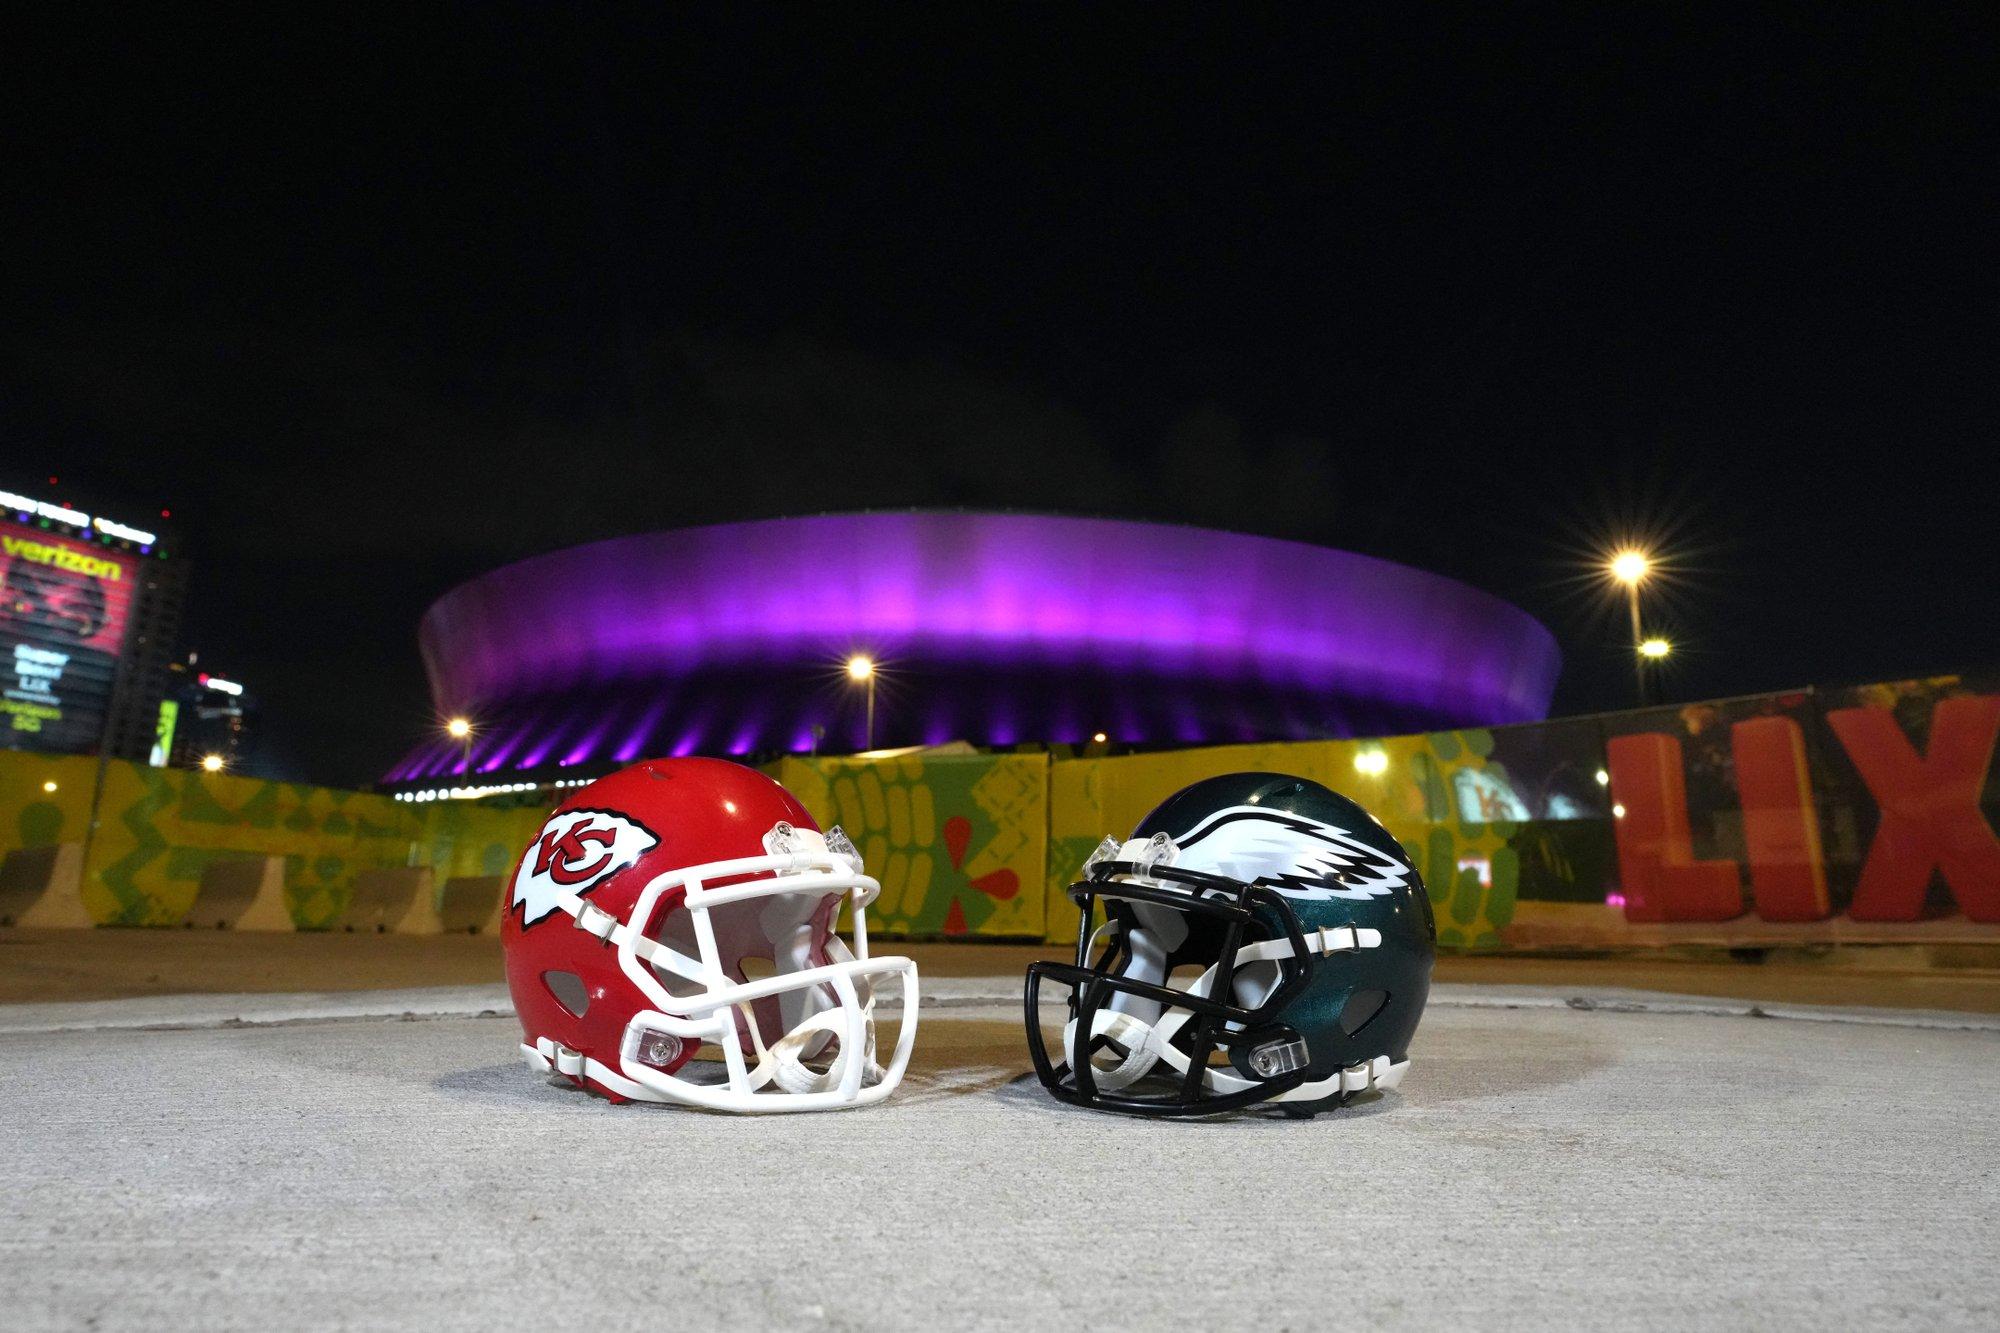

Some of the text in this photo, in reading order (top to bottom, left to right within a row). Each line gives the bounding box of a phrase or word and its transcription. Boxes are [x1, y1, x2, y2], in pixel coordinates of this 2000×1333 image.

[2, 535, 121, 581] verizon
[1607, 694, 2000, 923] LIX
[531, 817, 618, 886] KC
